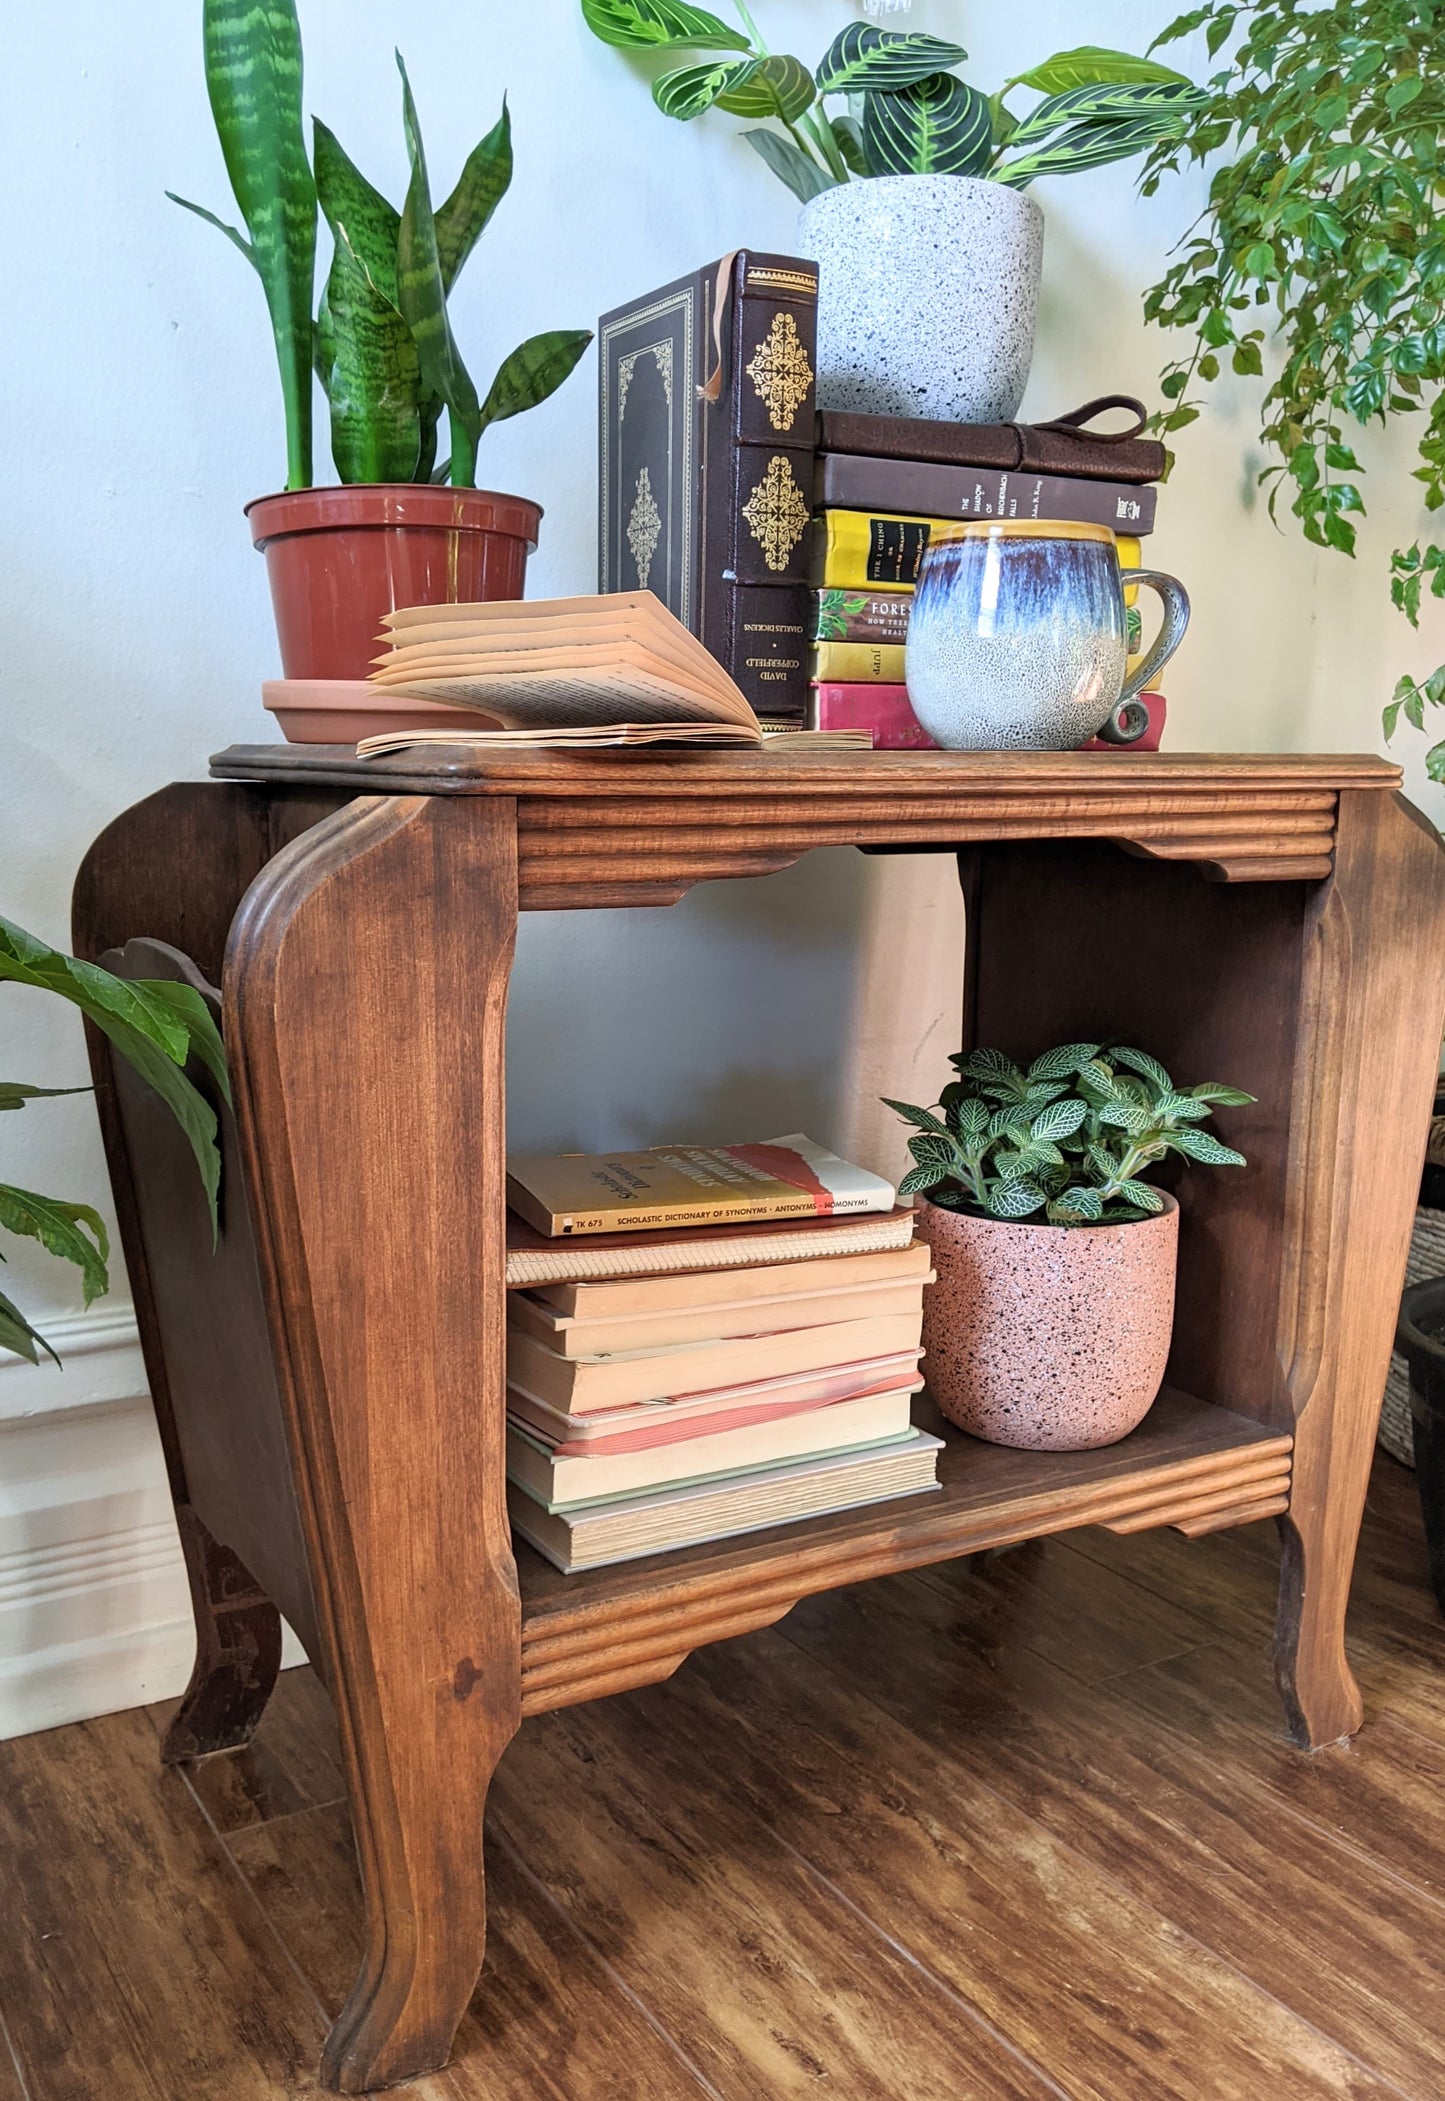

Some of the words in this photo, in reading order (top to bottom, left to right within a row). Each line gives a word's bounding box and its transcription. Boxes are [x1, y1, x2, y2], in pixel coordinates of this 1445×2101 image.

[1009, 498, 1017, 517] FALLS
[877, 522, 885, 551] CHING
[743, 624, 775, 633] DICKENS
[775, 624, 804, 633] CHARLES
[745, 658, 800, 669] COPPERFIELD
[871, 648, 881, 676] JUPP
[760, 671, 787, 681] DAVID
[617, 1214, 662, 1225] SCHOLASTIC
[665, 1211, 711, 1222] DICTIONARY
[713, 1209, 723, 1218] OF
[725, 1206, 767, 1217] SYNONYMS
[775, 1202, 816, 1213] ANTONYMS
[824, 1199, 868, 1209] HOMONYMS
[576, 1220, 586, 1229] TK
[588, 1219, 603, 1228] 675
